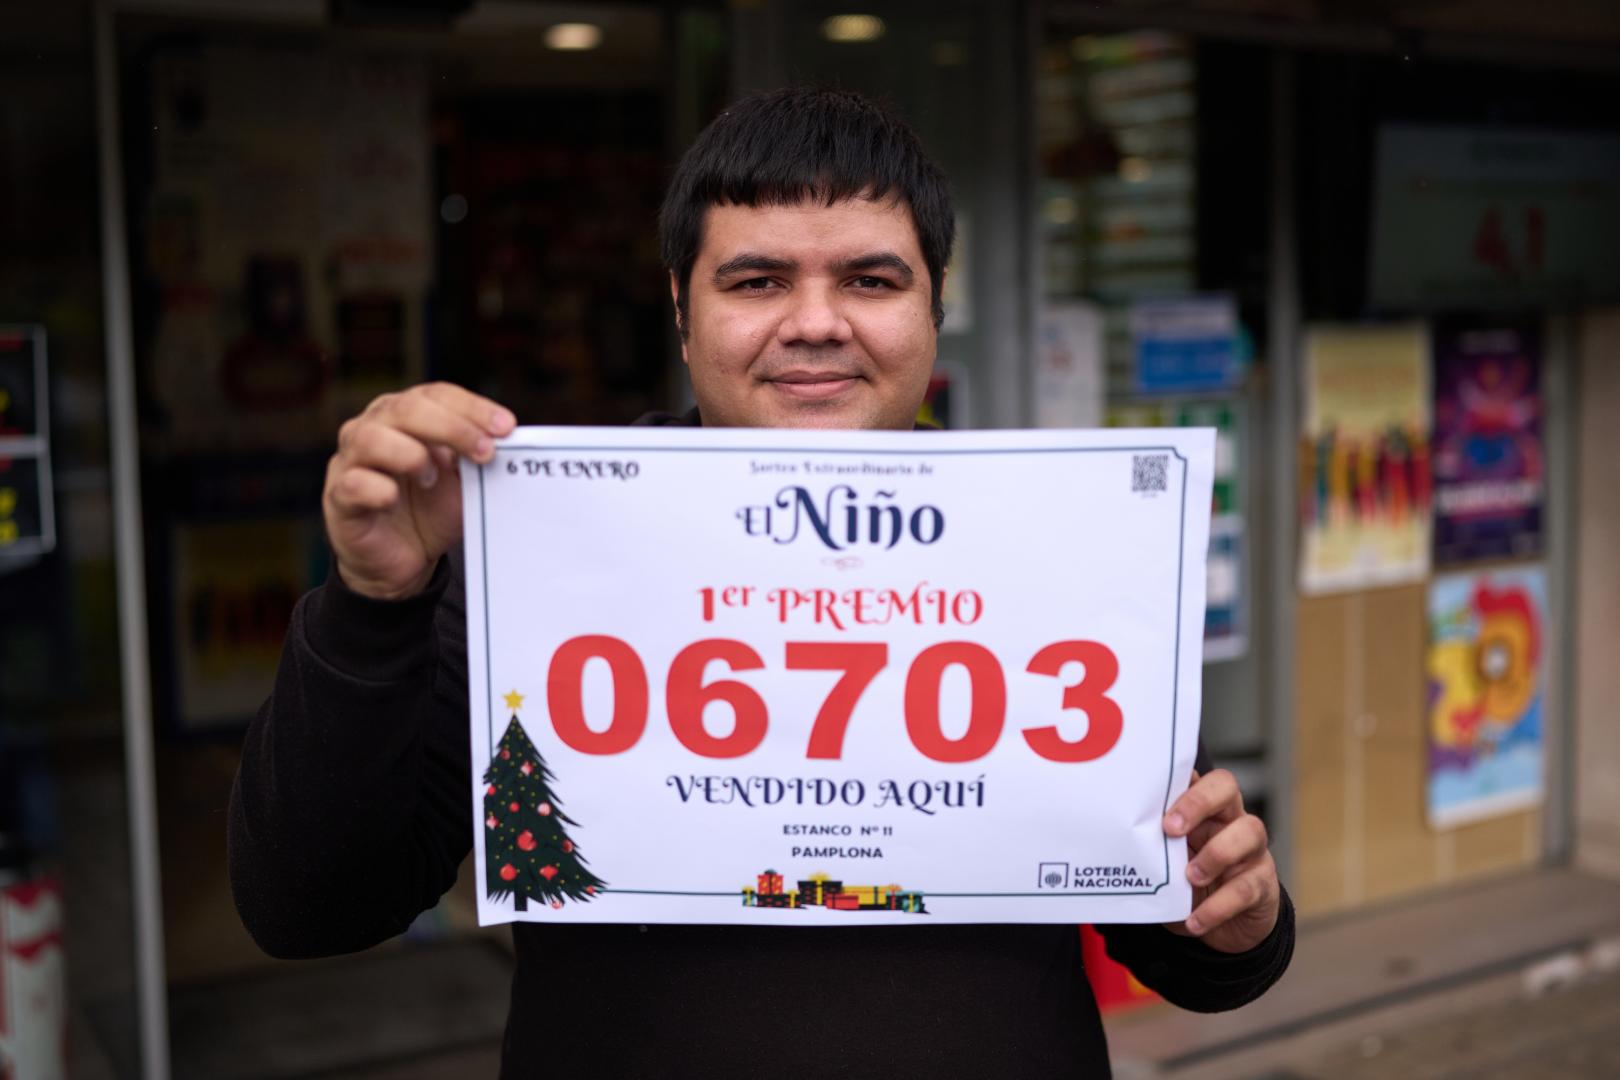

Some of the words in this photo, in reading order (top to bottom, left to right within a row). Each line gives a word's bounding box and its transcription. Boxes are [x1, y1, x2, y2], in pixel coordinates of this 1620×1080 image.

[506, 459, 519, 475] 6
[522, 459, 553, 476] DE
[559, 459, 640, 481] ENERO
[735, 504, 771, 536] El
[773, 484, 946, 551] Niño
[698, 585, 756, 623] 1er
[766, 580, 984, 631] PREMIO
[545, 633, 1124, 764] 06703
[665, 774, 866, 808] VENDIDO
[873, 774, 986, 815] AQUÍ
[783, 823, 852, 836] ESTANCO
[791, 846, 884, 859] PAMPLONA
[1074, 864, 1138, 877] LOTERÍA
[1073, 877, 1152, 888] NACIONAL
